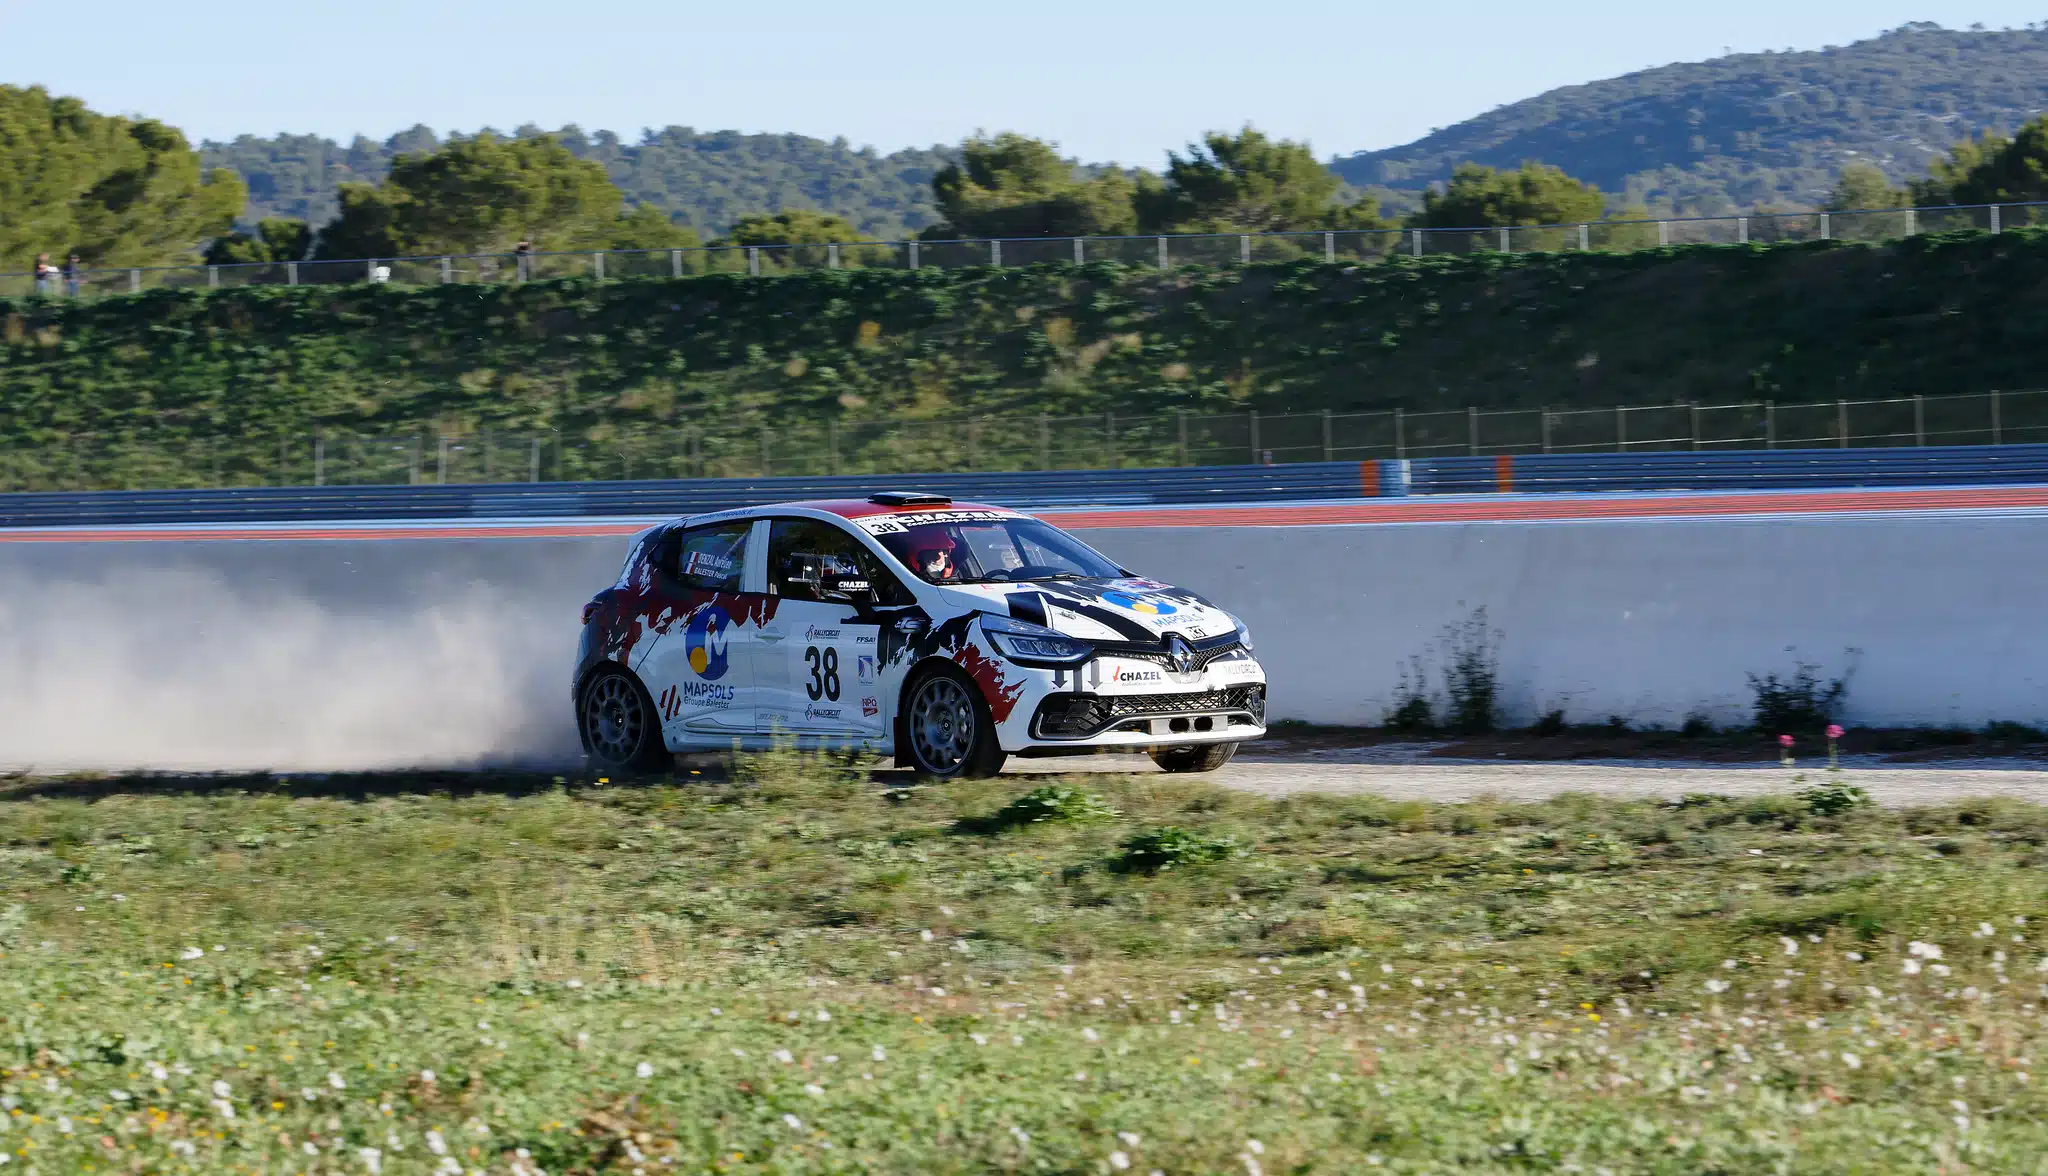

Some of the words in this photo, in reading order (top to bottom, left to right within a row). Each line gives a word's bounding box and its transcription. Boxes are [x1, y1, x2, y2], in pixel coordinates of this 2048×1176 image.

[898, 511, 1004, 523] CHAZEL
[875, 523, 899, 533] 38
[805, 645, 840, 702] 38
[1120, 671, 1161, 681] CHAZEL
[684, 681, 735, 700] MAPSOLS
[684, 696, 705, 707] Groupe
[706, 698, 730, 709] Balester
